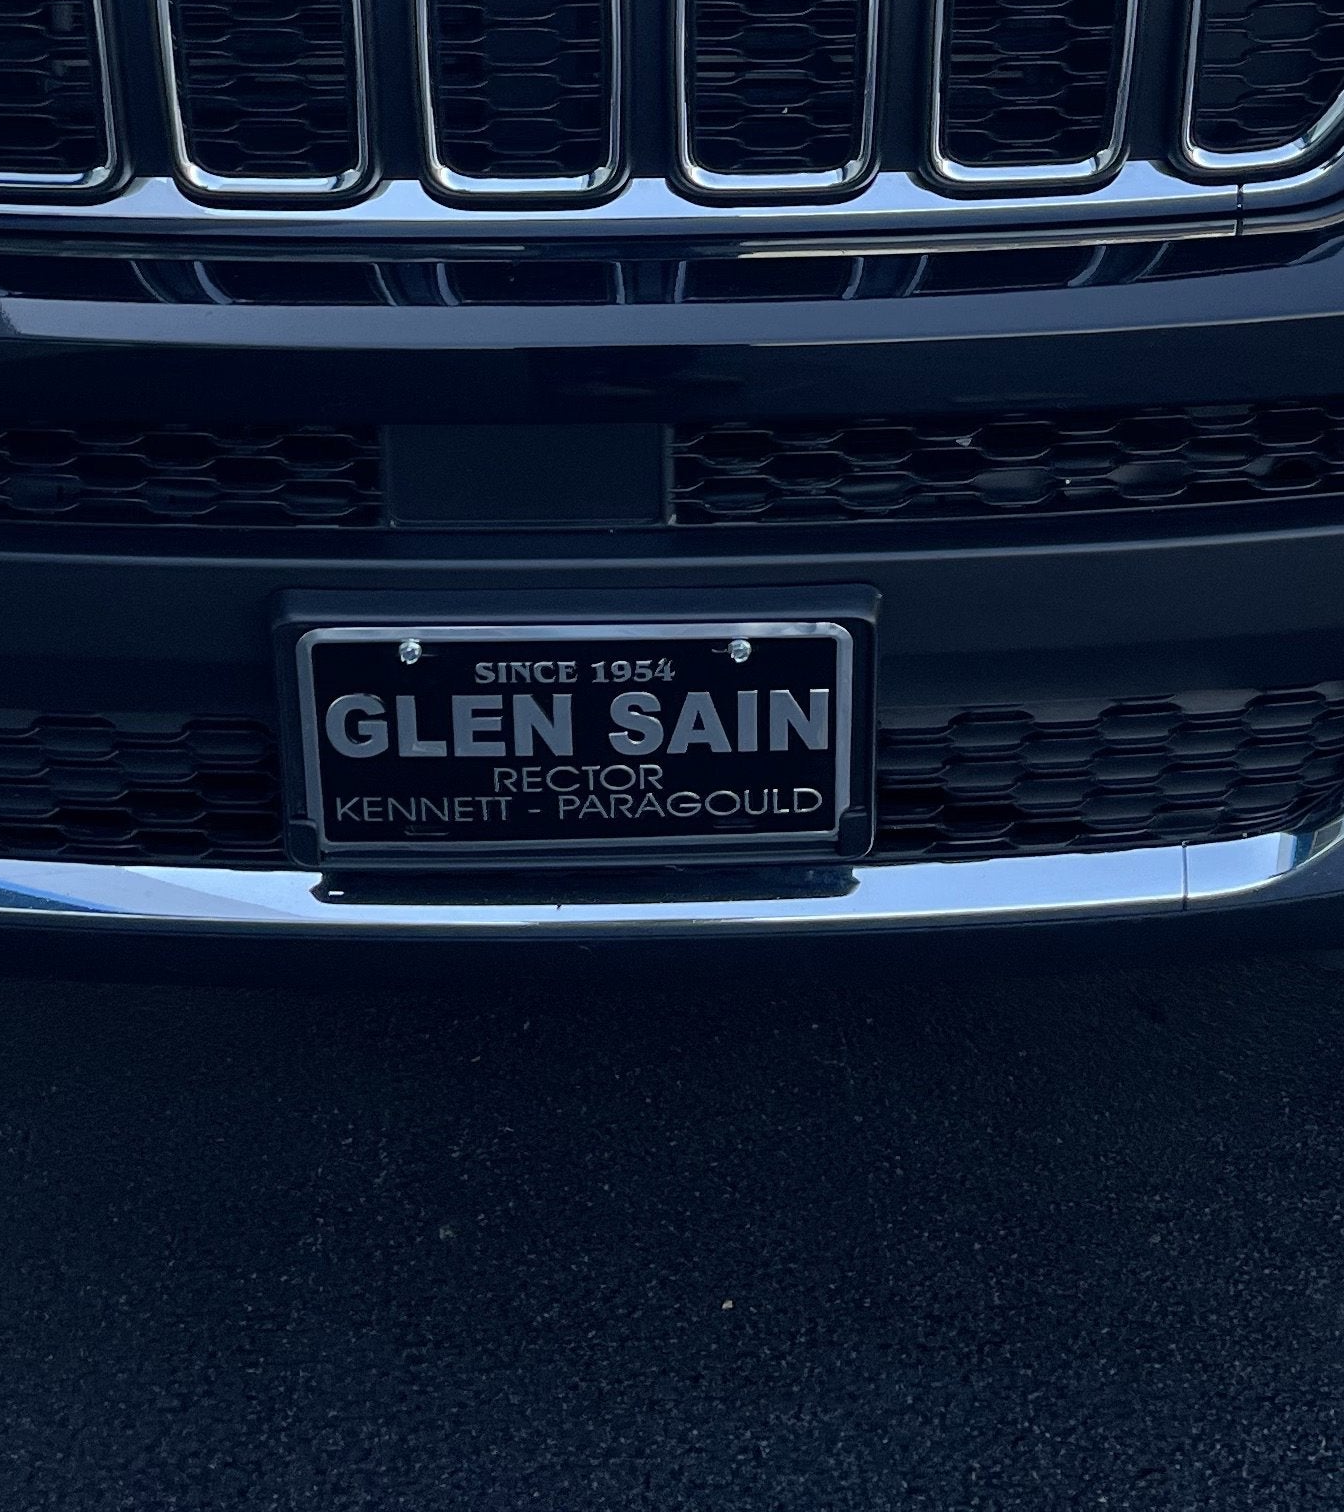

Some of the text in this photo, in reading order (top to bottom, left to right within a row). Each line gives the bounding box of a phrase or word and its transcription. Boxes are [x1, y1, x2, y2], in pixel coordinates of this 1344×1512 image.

[474, 657, 676, 684] SINCE 1954
[325, 687, 831, 759] GLEN SAIN
[493, 763, 664, 793] RECTOR
[336, 795, 512, 823] KENNETT
[558, 787, 824, 821] PARAGOULD
